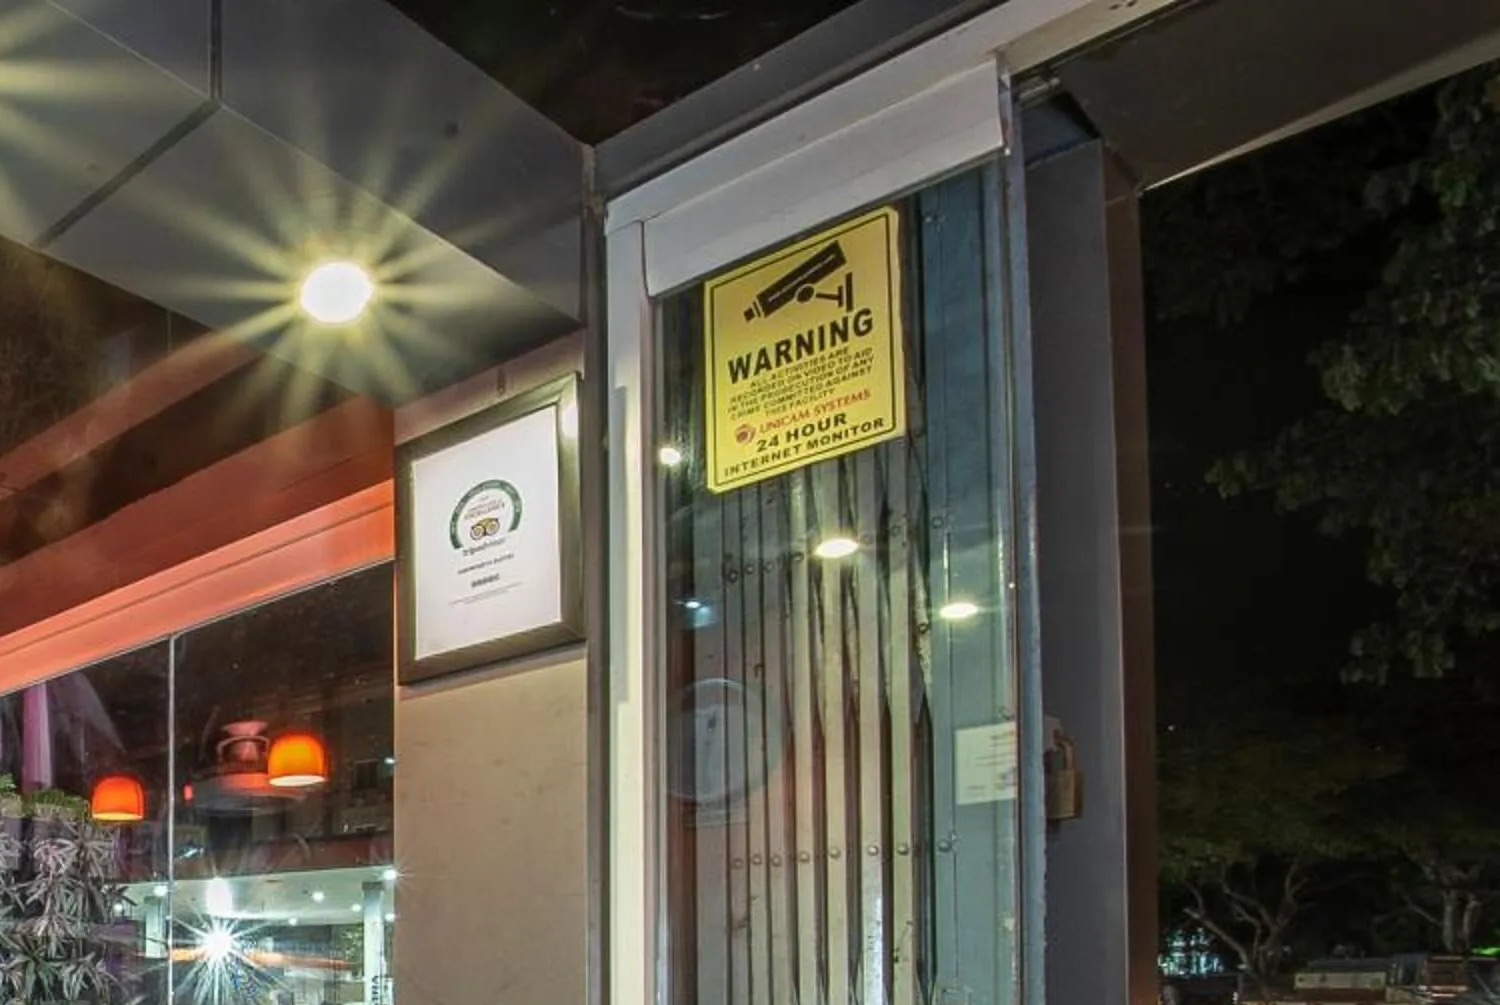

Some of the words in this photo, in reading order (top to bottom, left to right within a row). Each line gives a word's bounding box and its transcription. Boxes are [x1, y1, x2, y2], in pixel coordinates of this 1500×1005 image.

[728, 308, 874, 384] WARNING
[804, 358, 836, 376] VIDEO
[839, 352, 852, 365] TO
[854, 346, 872, 358] AID
[828, 346, 848, 360] ARE
[851, 355, 873, 369] ANY
[825, 365, 871, 387] AGAINST
[759, 408, 809, 434] UNICAM
[813, 386, 870, 415] SYSTEMS
[724, 442, 801, 477] INTERNET
[805, 416, 883, 450] MONITOR
[756, 433, 778, 453] 24
[786, 411, 846, 442] HOUR
